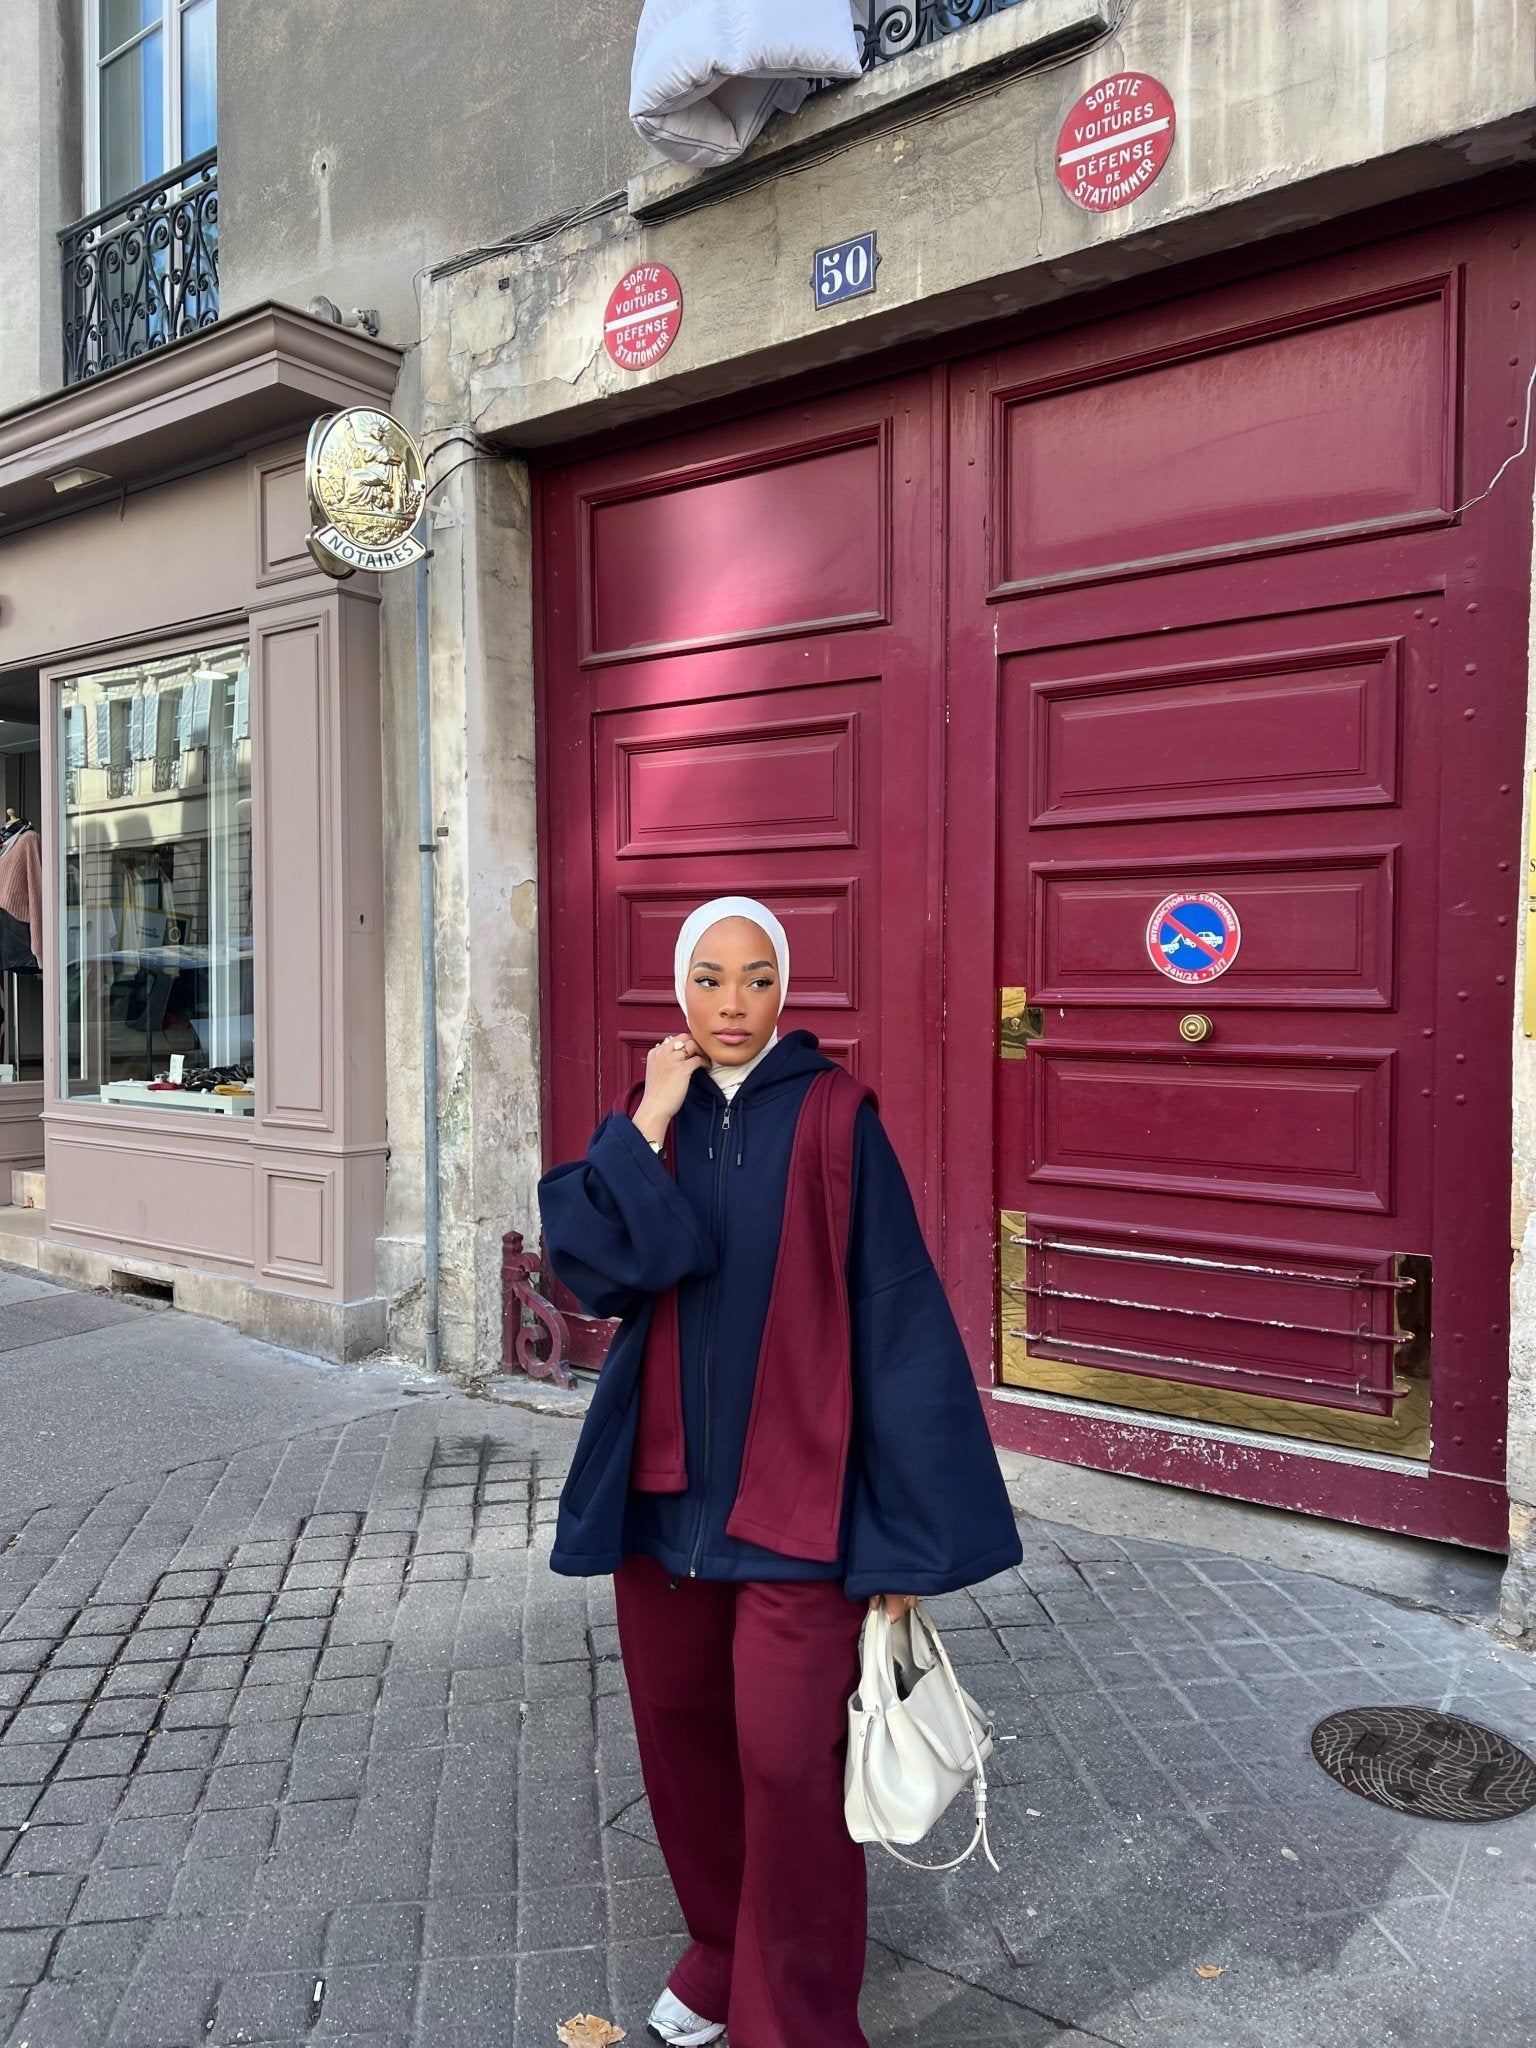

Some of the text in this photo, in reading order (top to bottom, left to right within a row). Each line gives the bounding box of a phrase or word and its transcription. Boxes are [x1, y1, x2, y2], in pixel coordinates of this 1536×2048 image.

[1085, 79, 1142, 111] SORTIE
[1104, 99, 1121, 114] DE
[1074, 102, 1154, 143] VOITURES
[1076, 140, 1154, 180] DÉFENSE
[1074, 158, 1156, 205] STATIONNER
[1105, 170, 1121, 184] DE
[623, 267, 660, 291] SORTIE
[821, 245, 868, 295] 50
[615, 288, 669, 315] VOITURES
[635, 283, 647, 294] DE
[616, 317, 669, 344] DÉFENSE
[636, 339, 647, 349] DE
[614, 332, 670, 365] STATIONNER
[328, 535, 414, 567] NOTAIRES
[1150, 896, 1184, 944] INTERDICTION
[1199, 894, 1236, 932] STATIONNER
[1164, 964, 1199, 980] 24H/24
